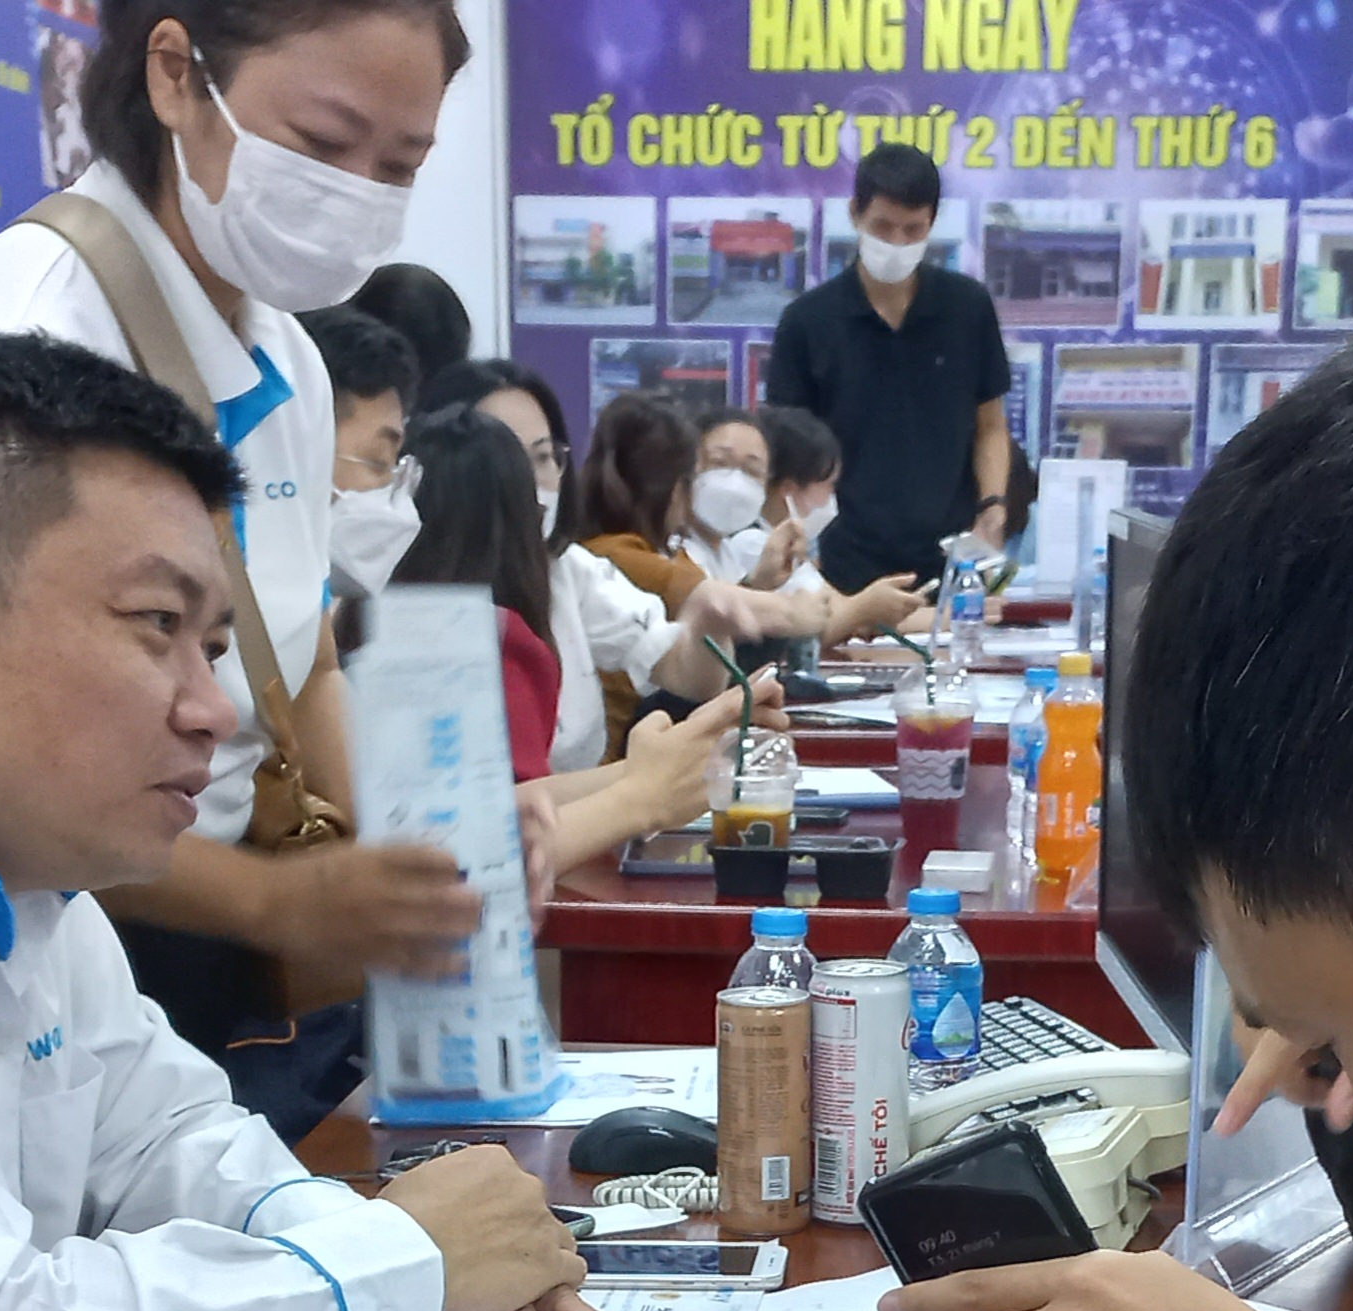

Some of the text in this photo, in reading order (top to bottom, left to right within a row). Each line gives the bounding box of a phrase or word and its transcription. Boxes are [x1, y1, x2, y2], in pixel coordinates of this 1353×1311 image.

[550, 92, 615, 167] TỔ
[627, 103, 762, 168] CHỨC
[776, 103, 845, 168] TỪ
[963, 115, 996, 169] 2
[1012, 98, 1116, 169] ĐẾN
[1132, 103, 1237, 169] THỨ
[1243, 115, 1277, 169] 6
